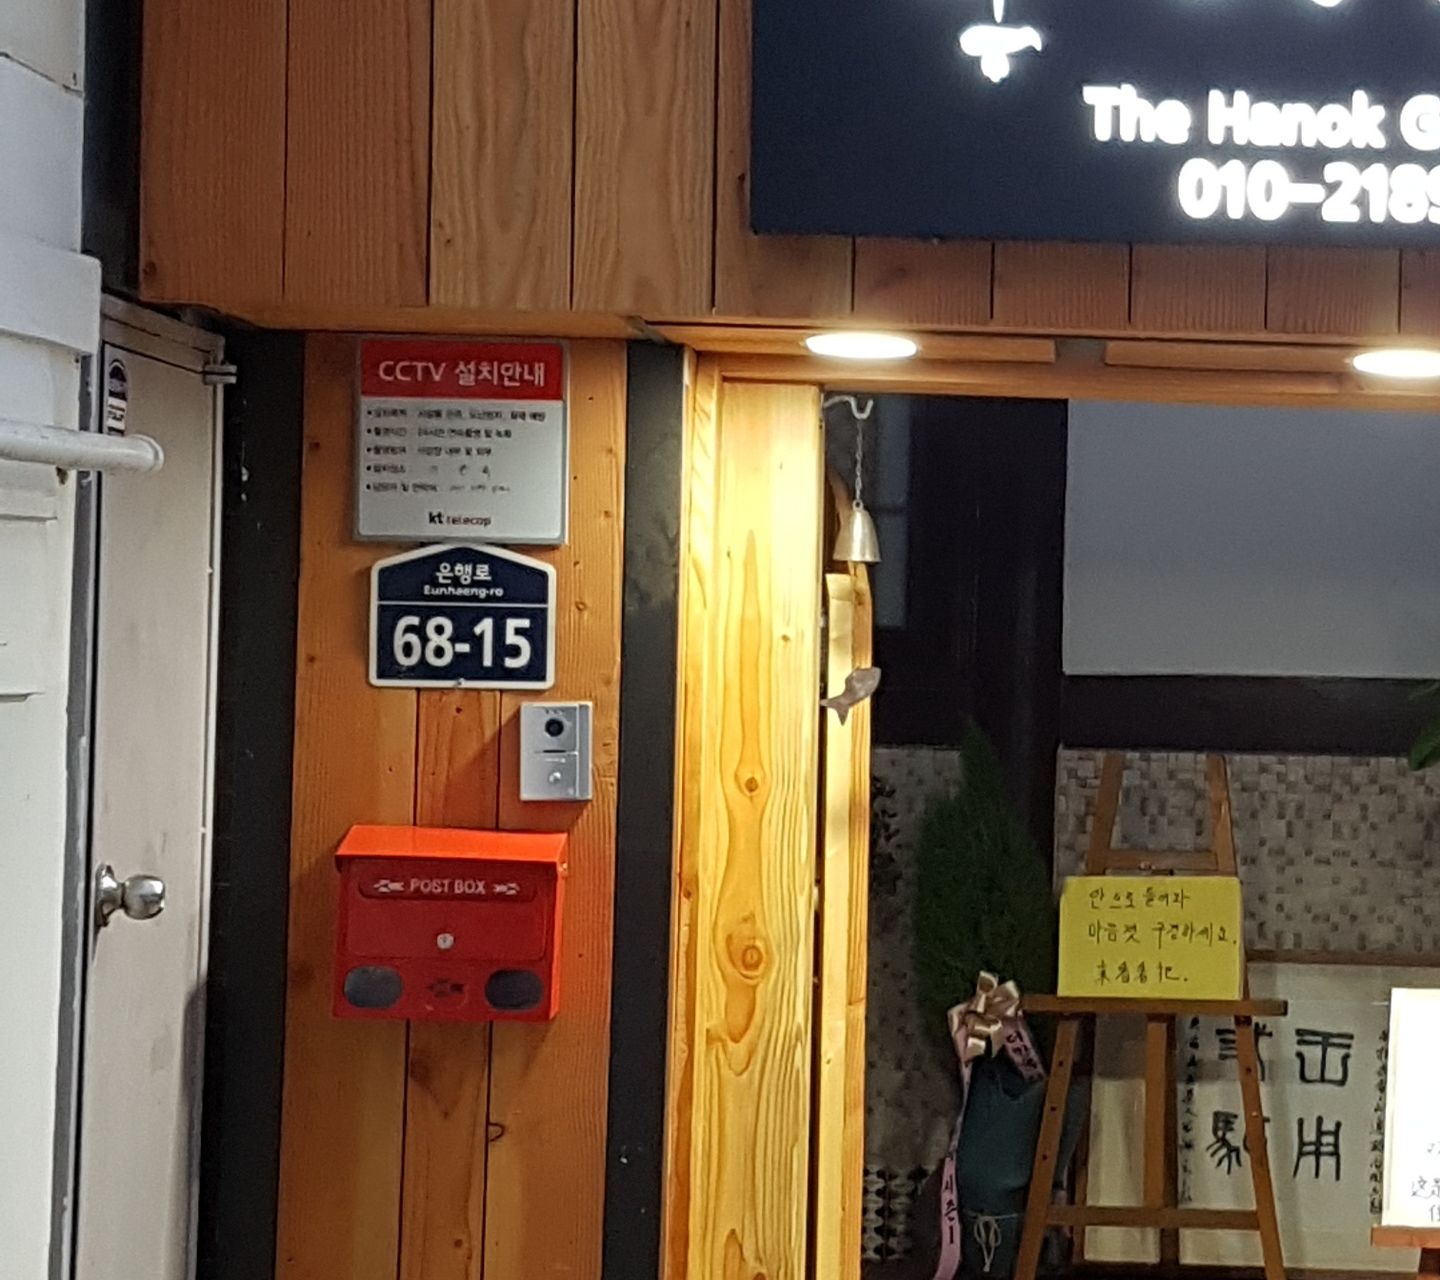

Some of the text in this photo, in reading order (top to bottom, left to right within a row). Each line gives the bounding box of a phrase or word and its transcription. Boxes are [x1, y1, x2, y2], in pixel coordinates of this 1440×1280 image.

[1081, 82, 1191, 144] The
[1207, 88, 1387, 149] Hanok
[378, 360, 545, 387] CCTV 설치안내
[428, 511, 443, 525] kt
[435, 562, 492, 585] 은행로
[423, 584, 505, 599] Eunhaeng-ro
[393, 615, 532, 669] 68-15
[410, 877, 486, 895] POST BOX
